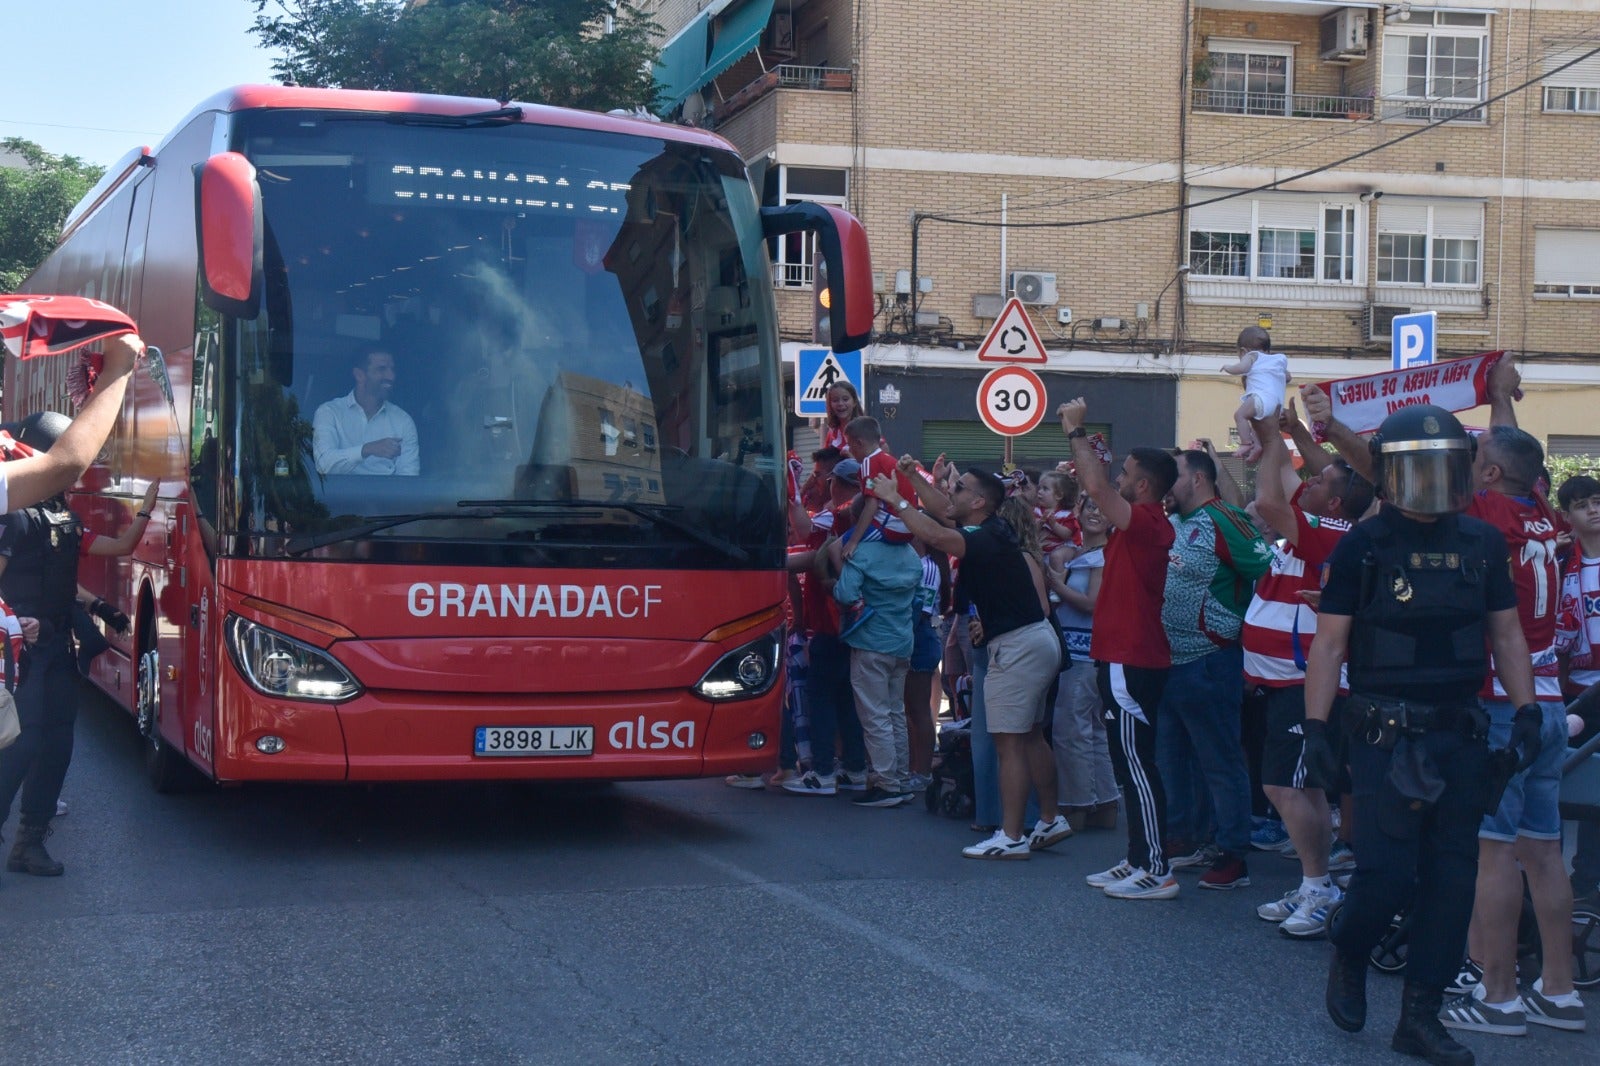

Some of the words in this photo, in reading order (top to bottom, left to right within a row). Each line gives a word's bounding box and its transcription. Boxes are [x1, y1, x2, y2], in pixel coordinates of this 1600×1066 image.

[1400, 323, 1425, 370] P
[994, 389, 1031, 411] 30
[194, 716, 212, 763] alsa
[489, 730, 542, 750] 3898
[549, 729, 588, 749] LJK
[608, 714, 695, 749] alsa
